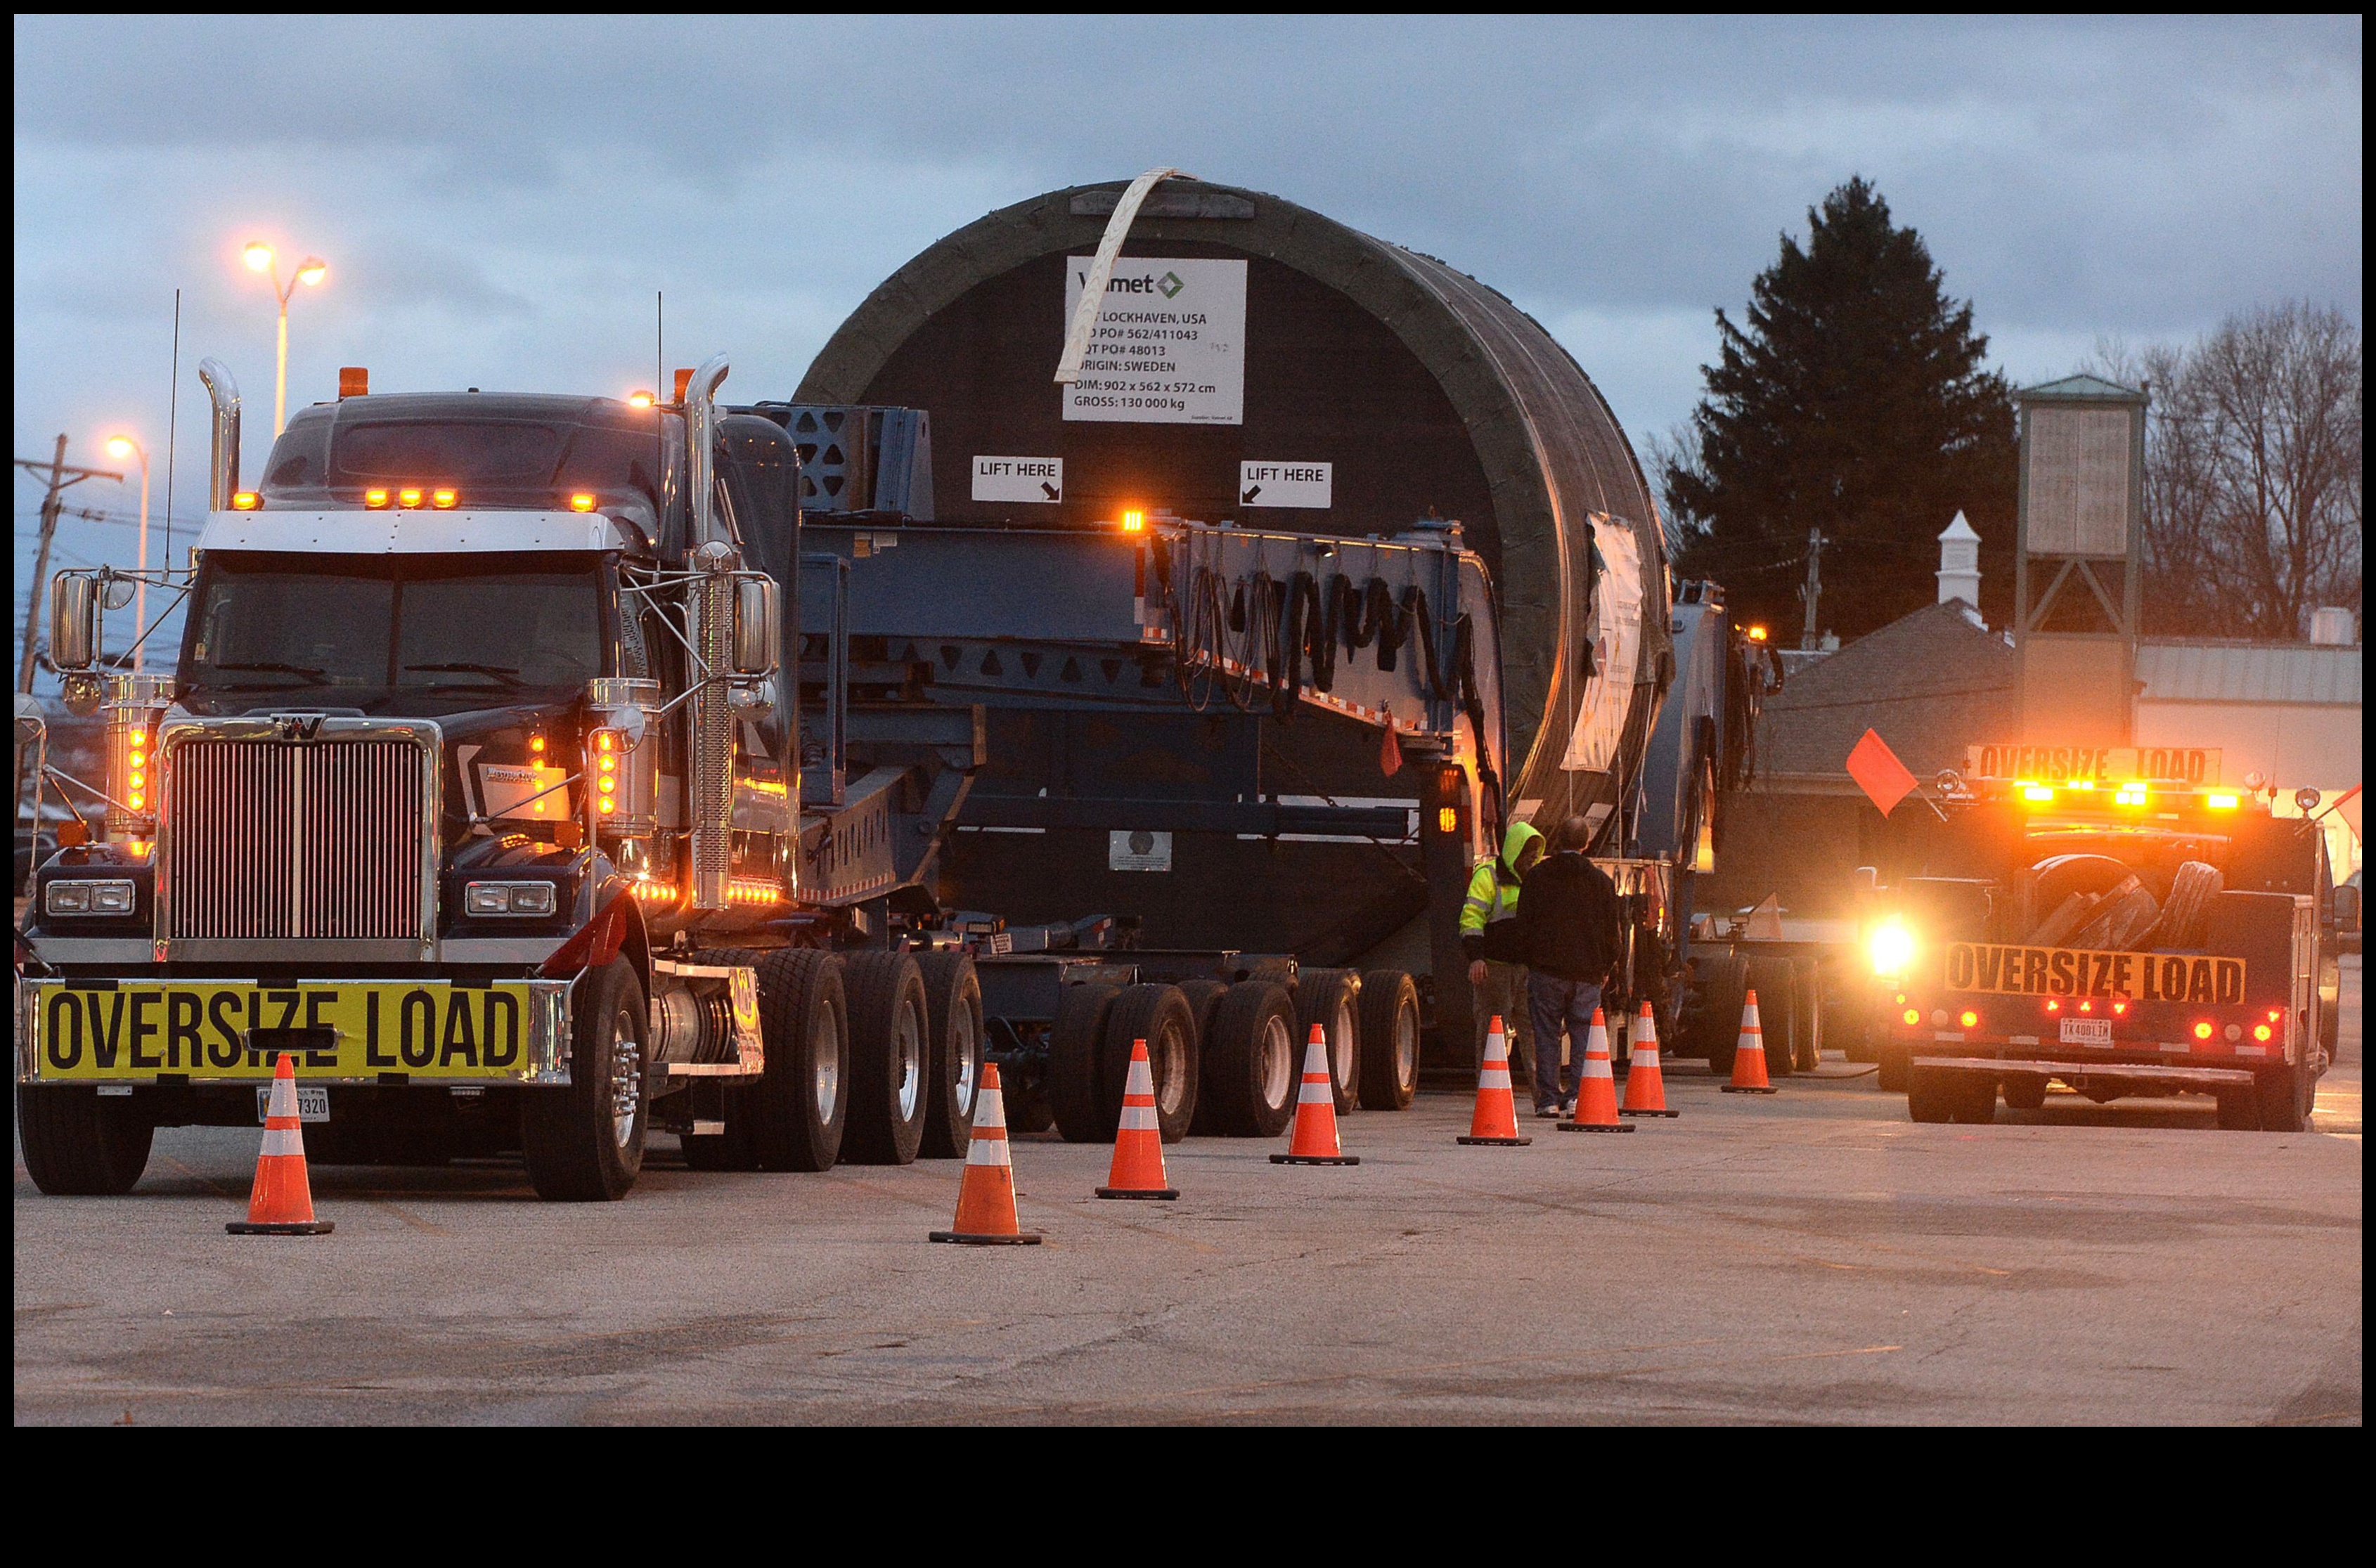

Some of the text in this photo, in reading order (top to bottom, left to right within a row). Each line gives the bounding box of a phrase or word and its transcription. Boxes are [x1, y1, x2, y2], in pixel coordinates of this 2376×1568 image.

[1103, 313, 1180, 325] LOCKHAVEN,
[1182, 313, 1207, 325] USA
[1100, 328, 1123, 339] PO#
[1127, 329, 1198, 340] 562/411043
[1102, 345, 1125, 354] PO#
[1129, 346, 1166, 356] 48013
[1125, 362, 1176, 372] SWEDEN
[1075, 380, 1102, 391] DIM:
[1104, 381, 1126, 391] 902
[1139, 382, 1161, 392] 562
[1174, 383, 1196, 394] 572
[1199, 384, 1216, 394] cm
[1074, 396, 1185, 412] GROSS: 130 000 kg
[980, 462, 1056, 477] LIFT HERE
[1247, 467, 1324, 482] LIFT HERE
[1980, 746, 2206, 785] OVERSIZE LOAD
[1948, 944, 2242, 1004] OVERSIZE LOAD
[47, 991, 519, 1070] OVERSIZE LOAD
[298, 1099, 326, 1113] 7320
